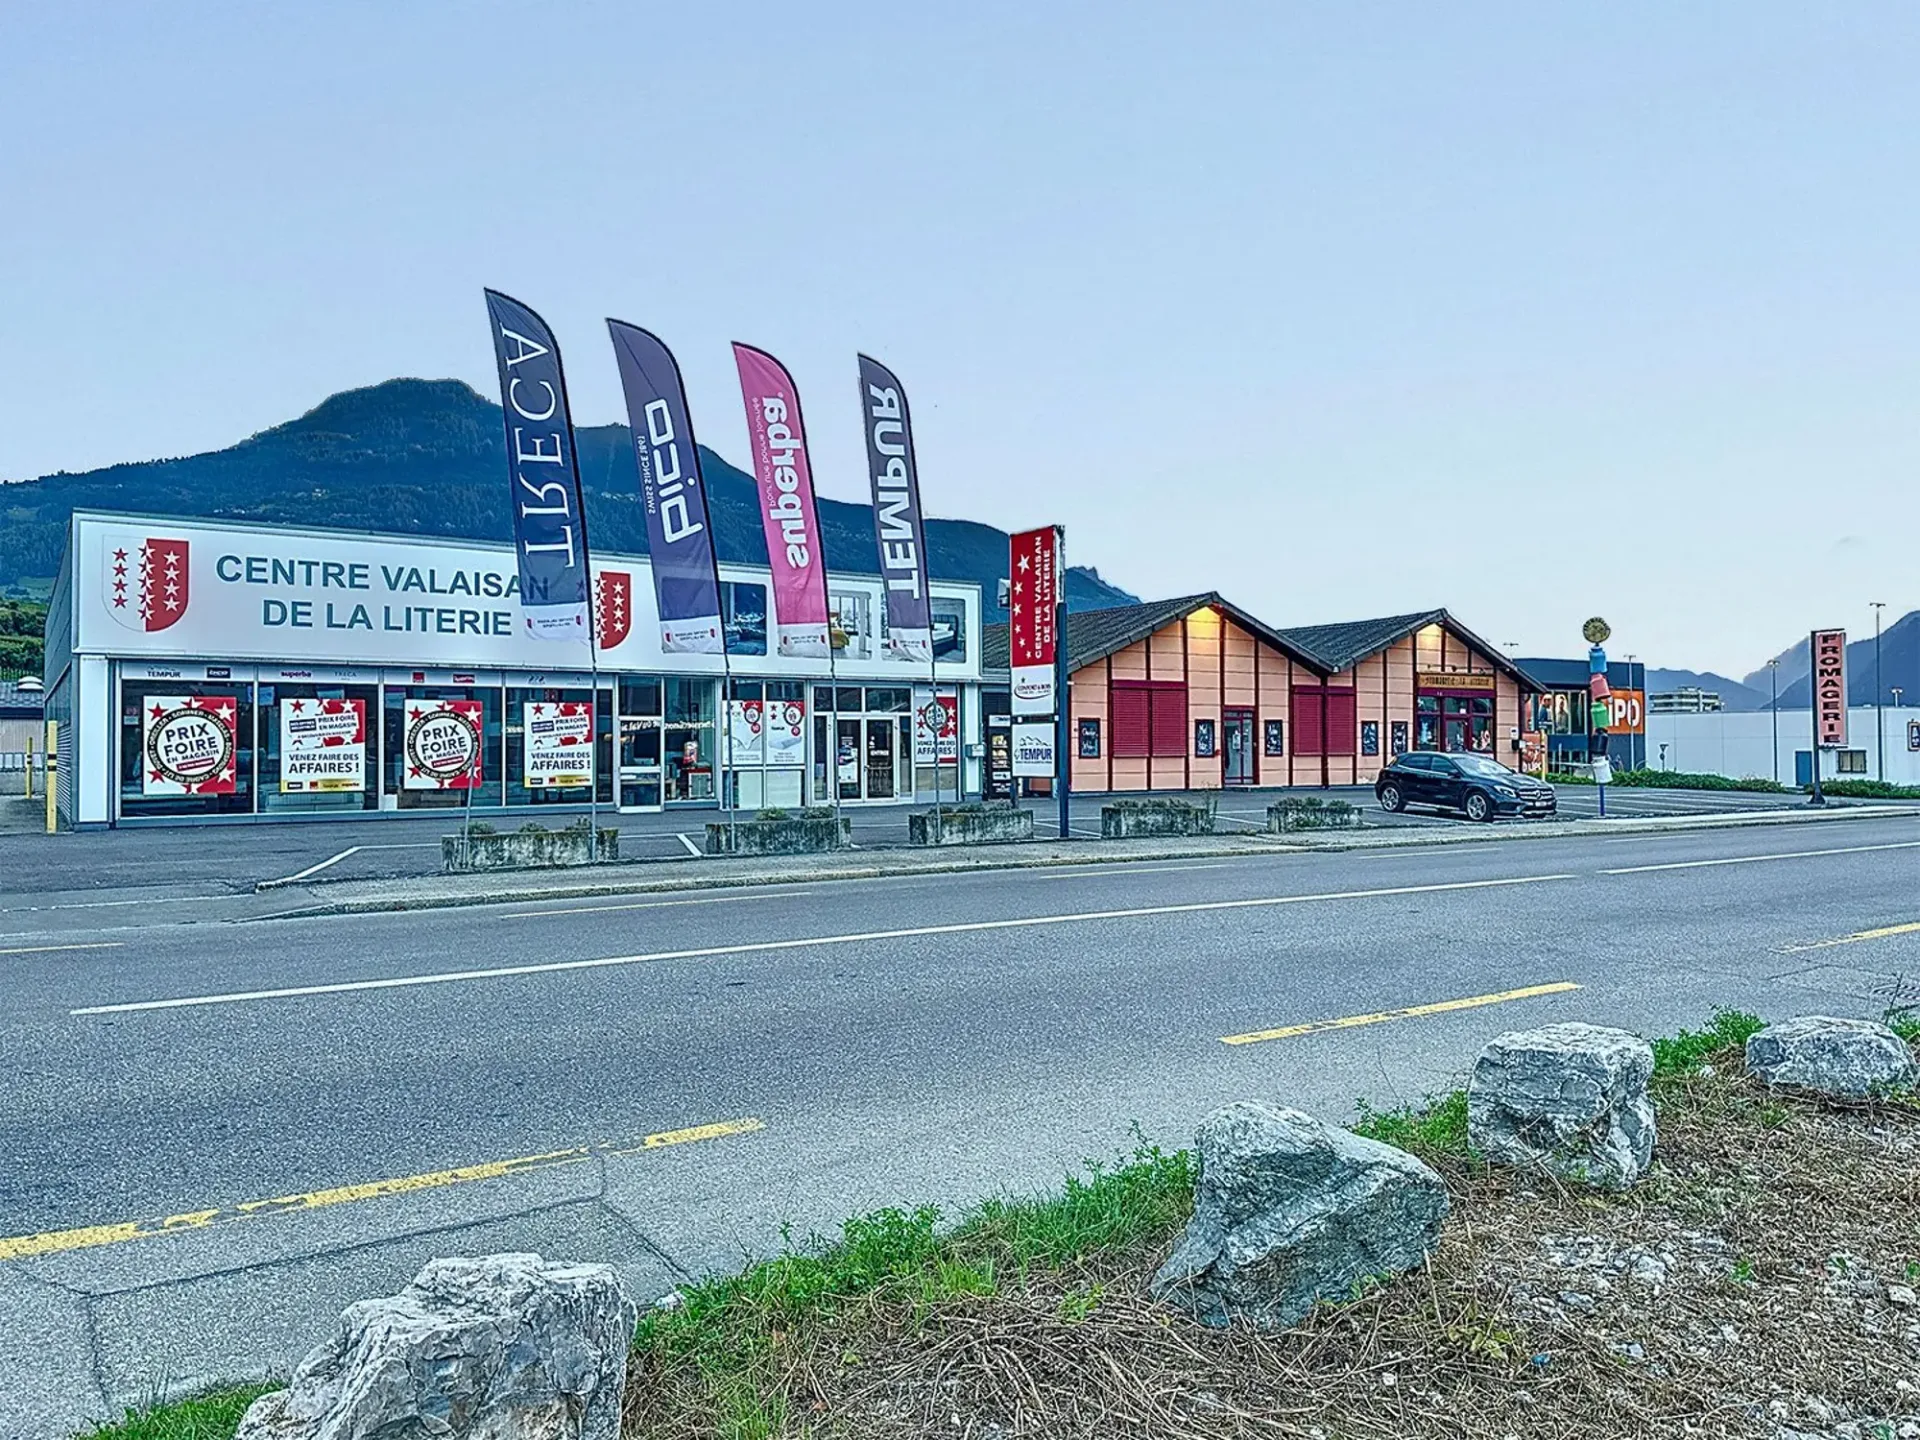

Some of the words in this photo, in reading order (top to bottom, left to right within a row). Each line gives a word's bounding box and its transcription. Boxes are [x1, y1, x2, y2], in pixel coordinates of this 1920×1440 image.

[216, 554, 370, 590] CENTRE
[262, 599, 313, 627] DE
[326, 602, 373, 630] LA
[383, 605, 512, 636] LITERIE
[1043, 604, 1050, 622] LA
[1043, 626, 1050, 643] DE
[1819, 634, 1841, 743] FROMAGERIE
[1608, 696, 1640, 727] iPO
[165, 723, 210, 743] PRIX
[422, 724, 460, 742] PRIX
[164, 736, 218, 757] FOIRE
[421, 736, 467, 755] FOIRE
[436, 748, 468, 758] MAGASIN
[918, 747, 952, 755] AFFARES
[1020, 748, 1052, 760] TEMPUR
[167, 756, 178, 764] EN
[182, 748, 220, 761] MAGASIN
[531, 760, 584, 770] AFFAIRES
[289, 762, 352, 774] AFFAIRES
[356, 762, 360, 772] !
